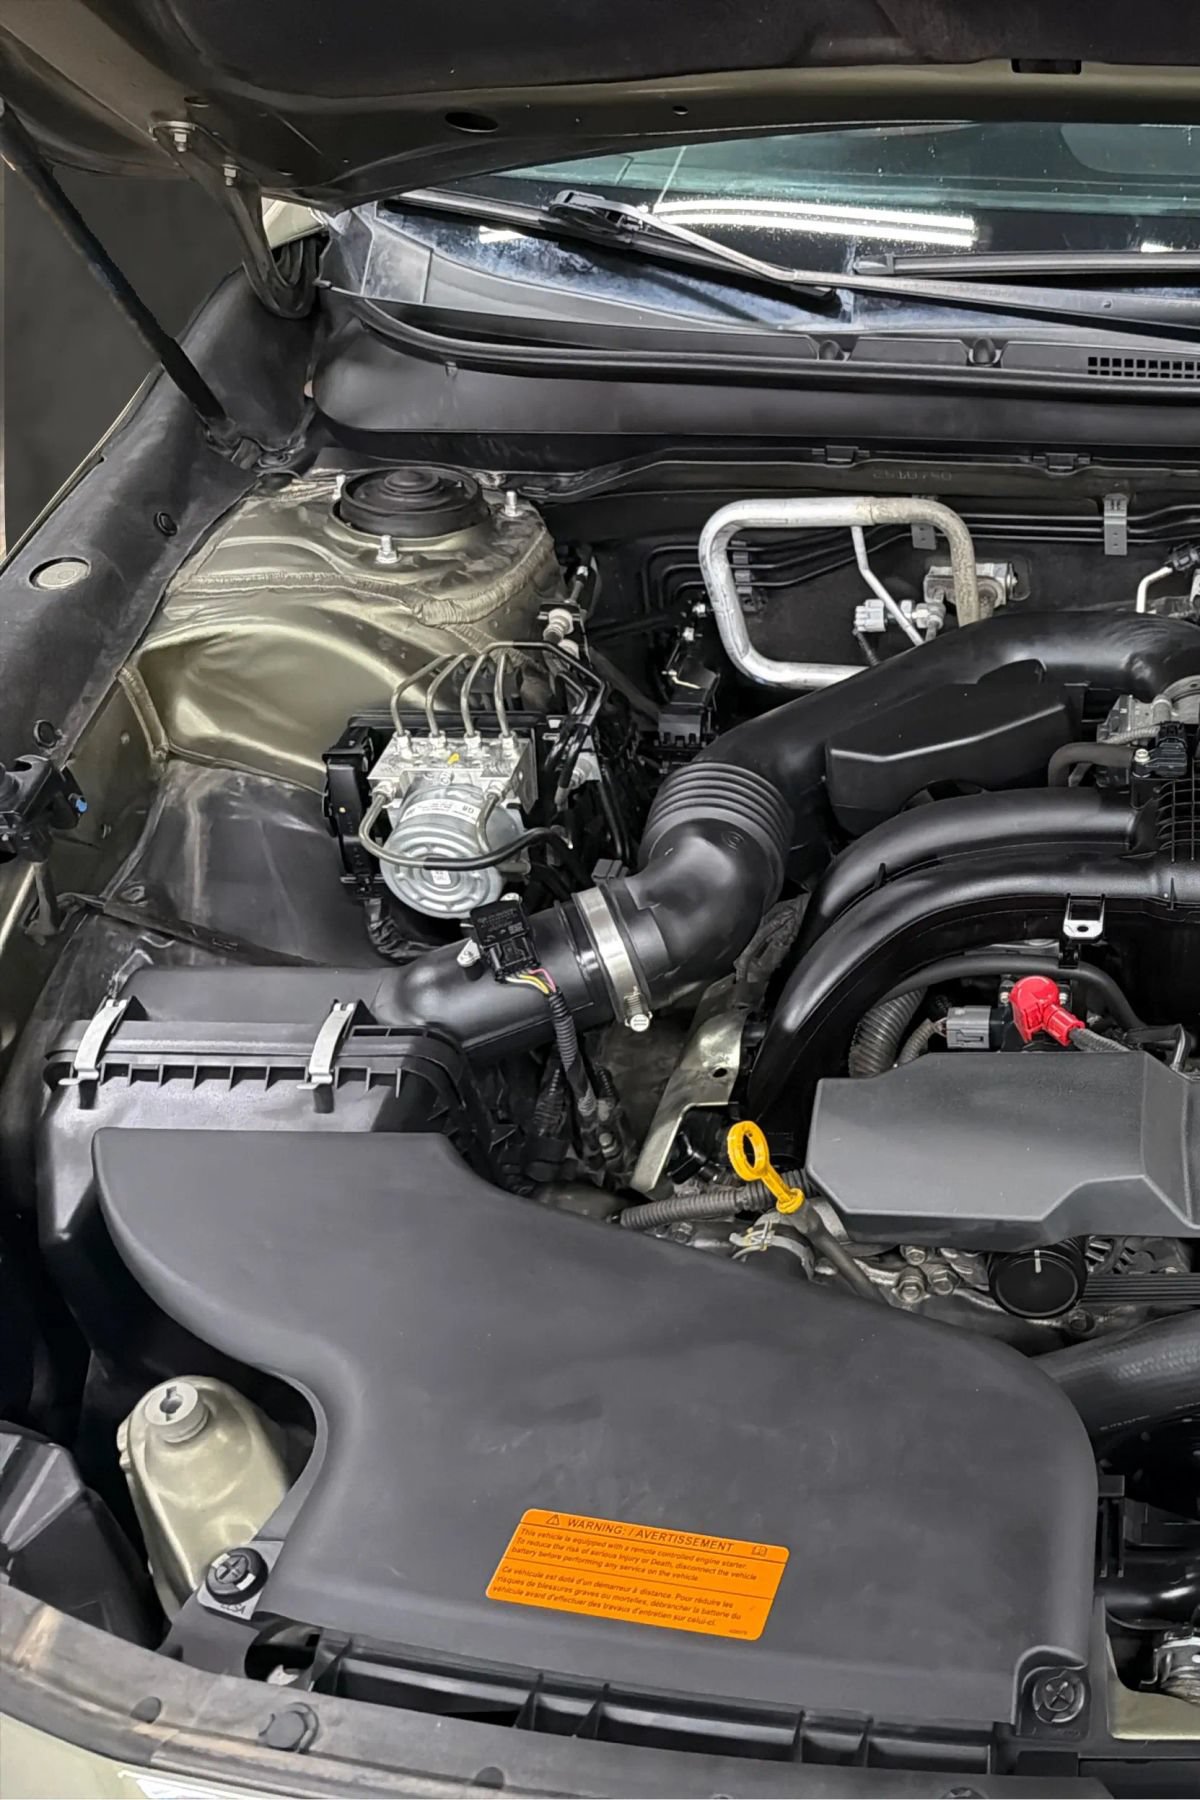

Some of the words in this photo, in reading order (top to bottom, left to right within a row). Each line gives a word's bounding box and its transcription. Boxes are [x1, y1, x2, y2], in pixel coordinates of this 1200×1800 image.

[537, 1531, 563, 1540] vehicle
[694, 1555, 721, 1566] engine
[634, 1529, 734, 1551] AVERTISSEMENT
[510, 1546, 537, 1557] battery
[537, 1550, 562, 1559] before
[562, 1554, 603, 1567] performing
[619, 1563, 646, 1572] service
[675, 1561, 716, 1574] disconnect
[716, 1568, 729, 1576] the
[730, 1570, 757, 1580] vehicle
